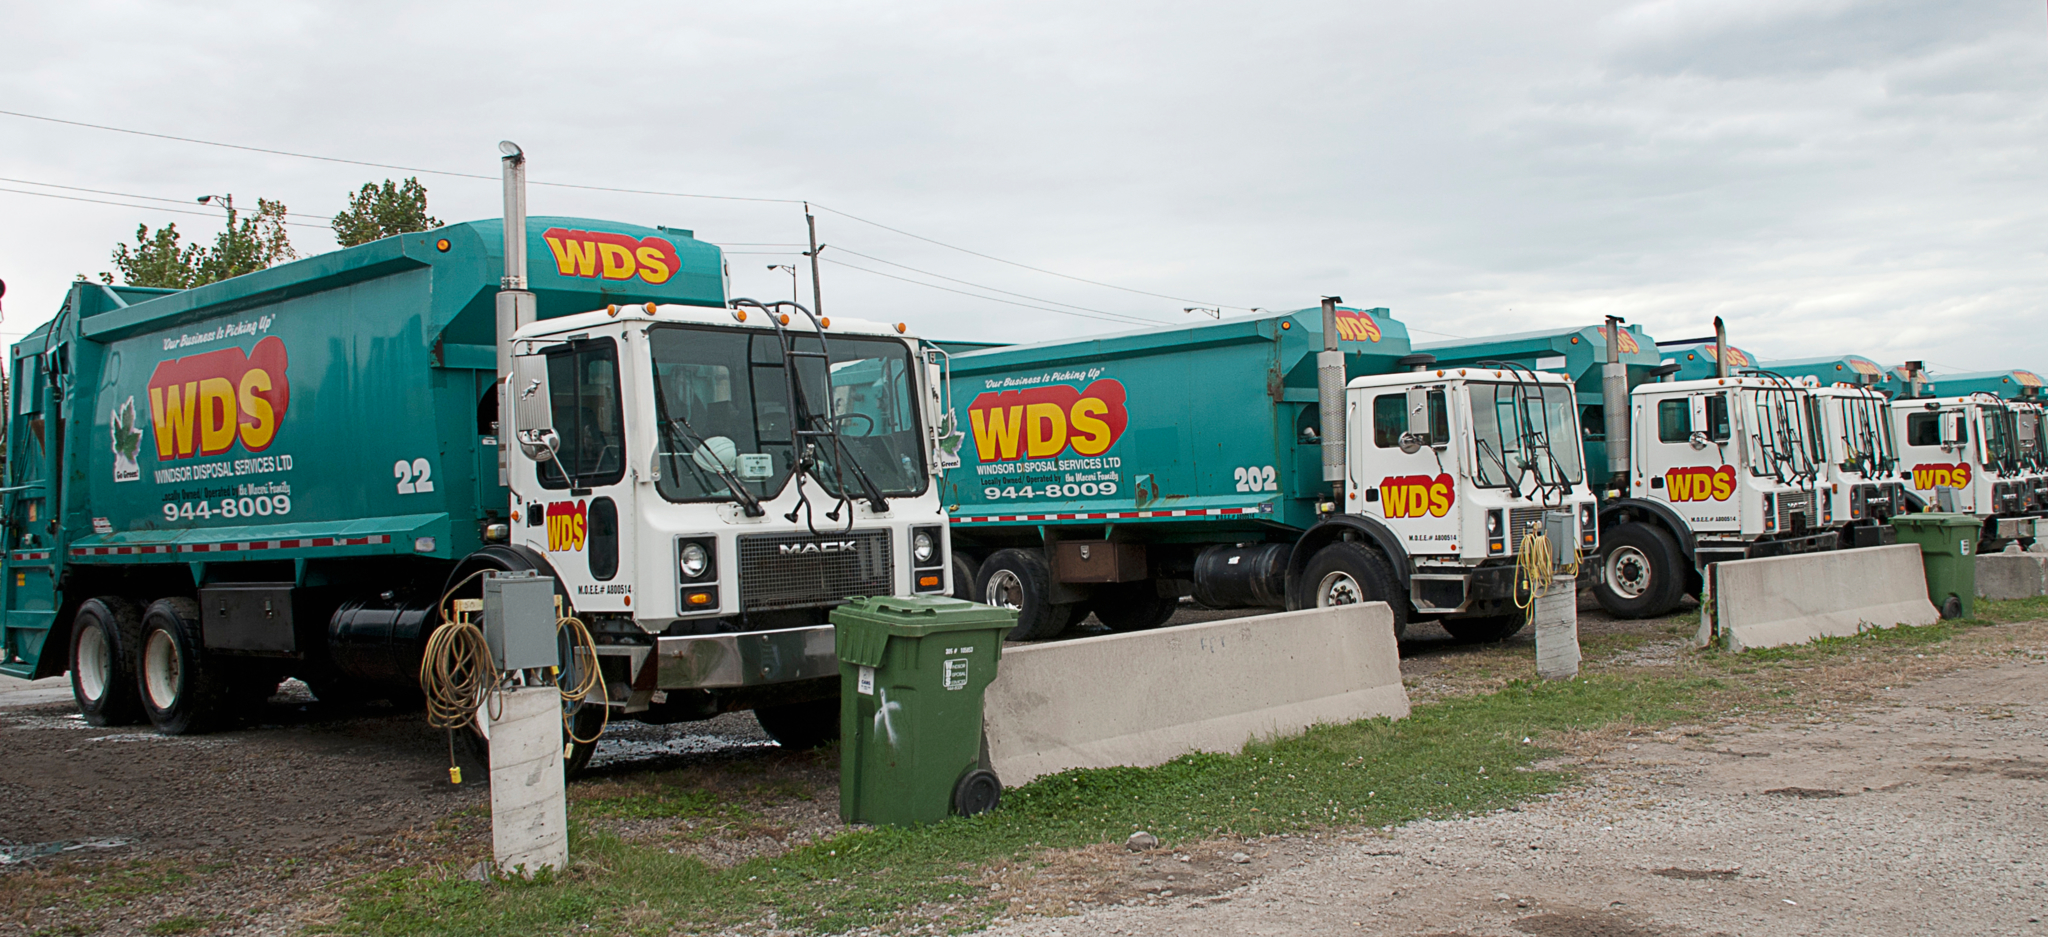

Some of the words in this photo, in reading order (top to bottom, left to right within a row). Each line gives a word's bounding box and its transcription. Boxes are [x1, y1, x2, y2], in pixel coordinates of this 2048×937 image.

[544, 233, 673, 284] WDS
[180, 331, 215, 348] Business
[216, 326, 224, 340] Is
[224, 320, 258, 338] Picking
[1003, 376, 1041, 387] Business
[1041, 373, 1050, 383] Is
[1051, 370, 1086, 383] Picking
[1088, 367, 1105, 380] Up"
[148, 355, 282, 460] WDS
[970, 390, 1119, 462] WDS
[154, 466, 192, 484] WINDSOR
[192, 461, 234, 480] DISPOSAL
[234, 456, 275, 476] SERVICES
[276, 454, 293, 472] LTD
[394, 458, 434, 494] 22
[976, 463, 1015, 476] WINDSOR
[1058, 457, 1102, 471] SERVICES
[1103, 456, 1121, 469] LTD
[980, 477, 1001, 486] Locally
[1026, 474, 1053, 484] Operated
[1053, 474, 1061, 484] by
[1065, 473, 1075, 483] the
[1097, 470, 1119, 482] Family
[1234, 465, 1278, 493] 202
[1912, 466, 1968, 490] WDS
[204, 485, 231, 499] Operated
[231, 484, 239, 498] by
[984, 482, 1118, 500] 944-8009
[1380, 479, 1452, 518] WDS
[1666, 469, 1734, 502] WDS
[162, 494, 292, 522] 944-8009
[546, 508, 586, 552] WDS
[779, 541, 857, 555] MACK
